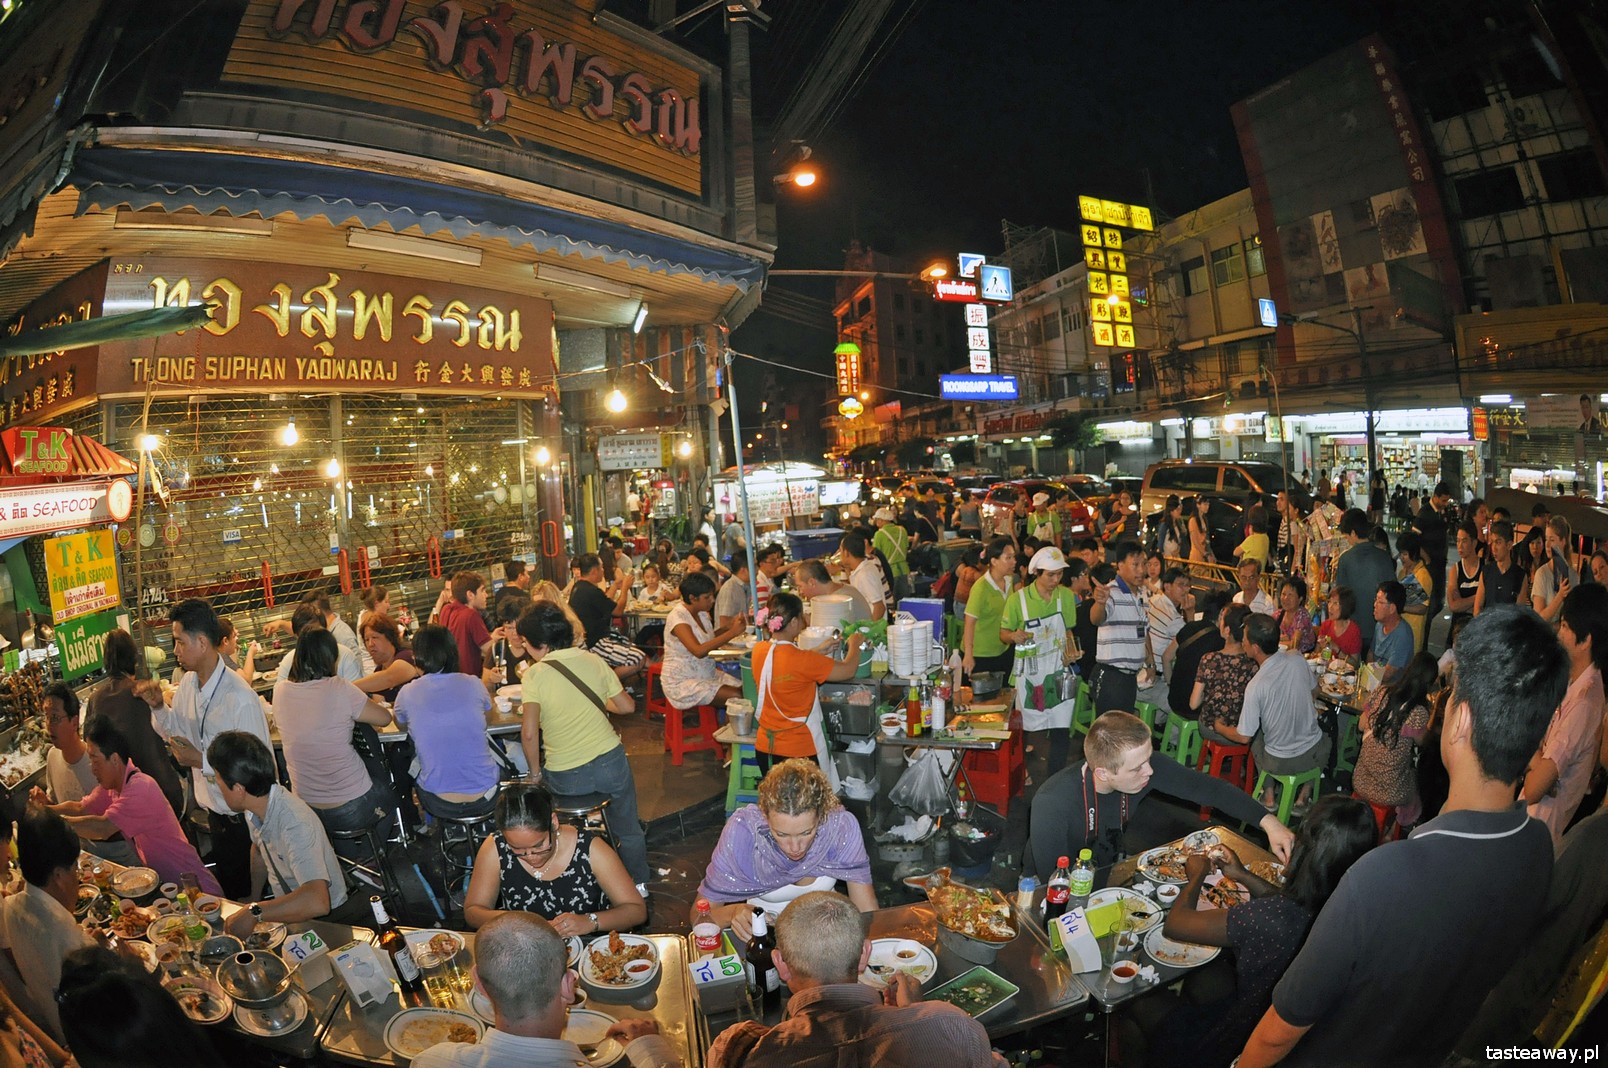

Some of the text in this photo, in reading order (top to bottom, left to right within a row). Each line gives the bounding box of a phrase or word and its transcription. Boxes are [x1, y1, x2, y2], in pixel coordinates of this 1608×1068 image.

[131, 356, 398, 382] THONG SUPHAN YAOWARAJ
[850, 354, 859, 393] HOTEL
[989, 381, 1016, 393] TRAVEL
[20, 461, 68, 474] SEAFOOD
[33, 497, 98, 518] SEAFOOD
[225, 531, 240, 539] VISA
[57, 534, 103, 568] T & K
[89, 566, 114, 583] SEAFOOD
[1088, 807, 1096, 831] Canon
[719, 956, 742, 976] 5
